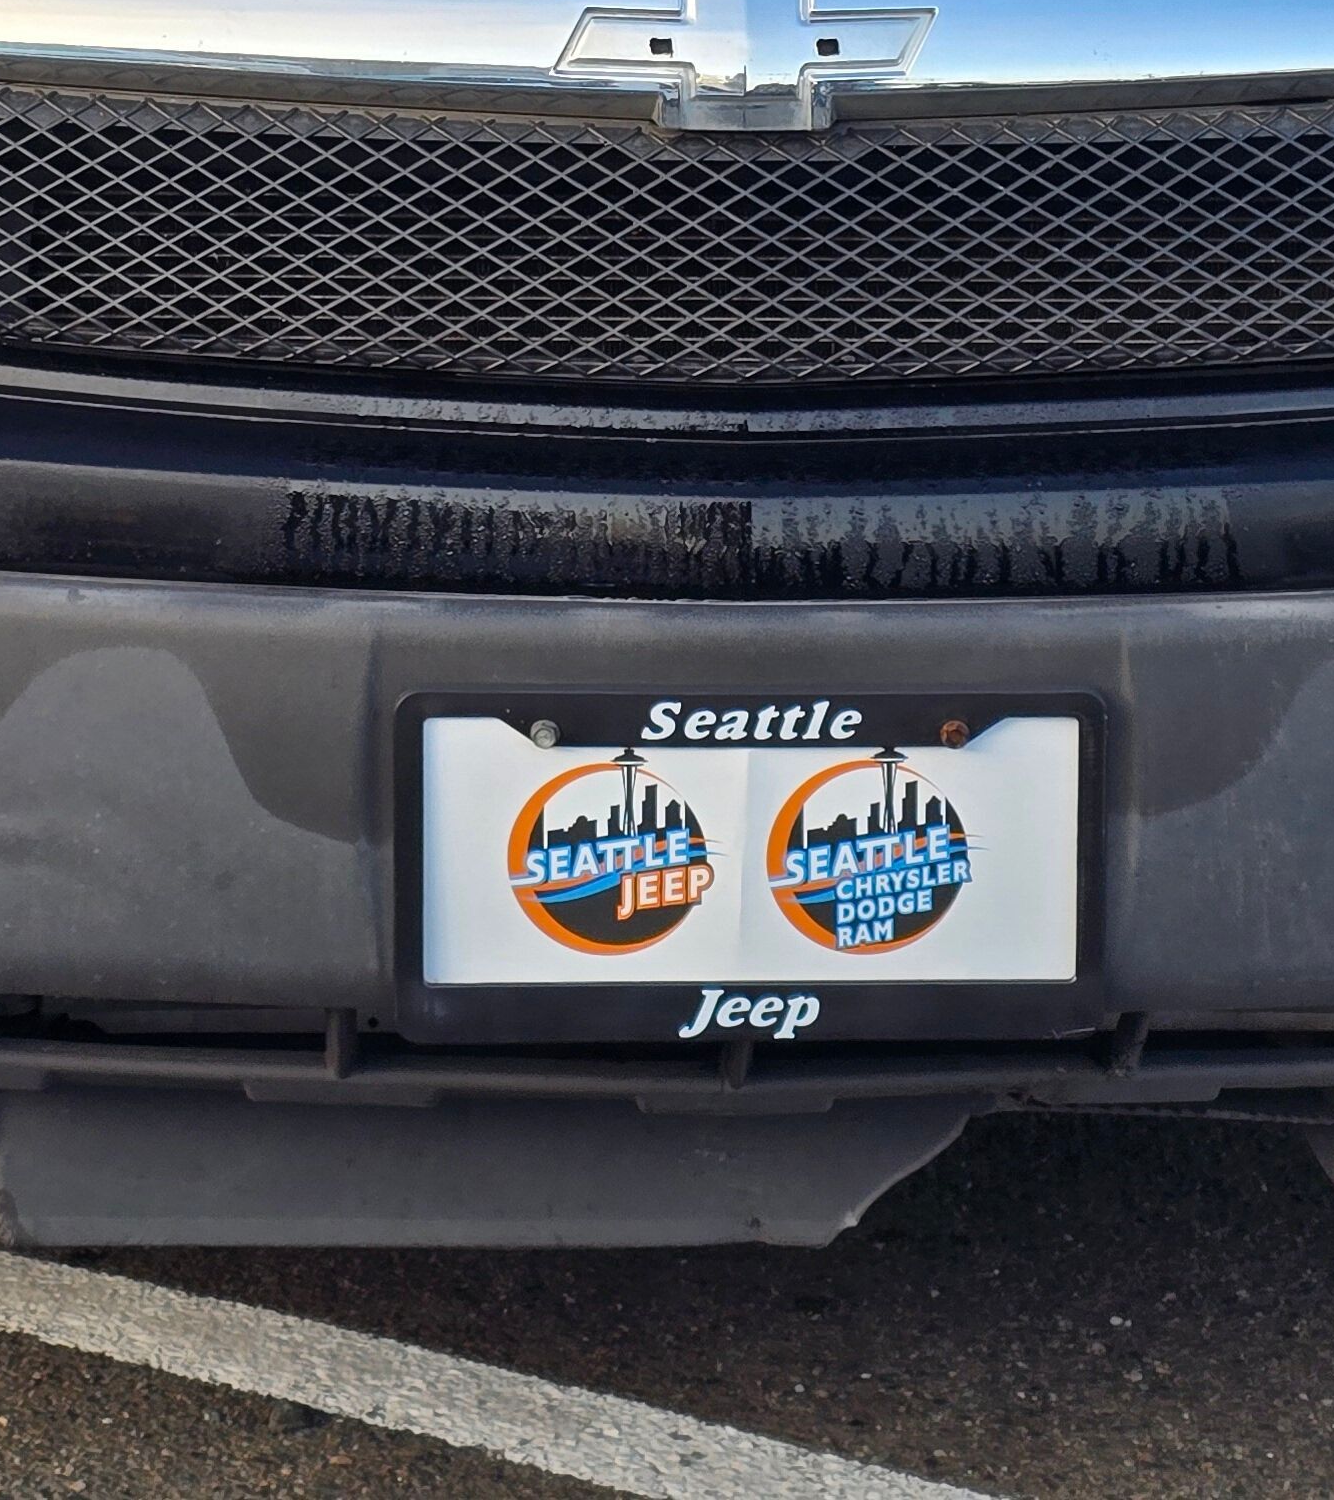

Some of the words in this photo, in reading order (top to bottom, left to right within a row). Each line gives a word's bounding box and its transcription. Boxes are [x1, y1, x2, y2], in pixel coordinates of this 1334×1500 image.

[641, 701, 862, 741] Seattle
[525, 829, 689, 884] SEATTLE
[786, 826, 949, 884] SEATTLE
[618, 866, 712, 920] JEEP
[836, 861, 971, 899] CHRYSLER
[837, 891, 932, 924] DODGE
[837, 920, 894, 947] RAM
[679, 989, 821, 1040] Jeep
